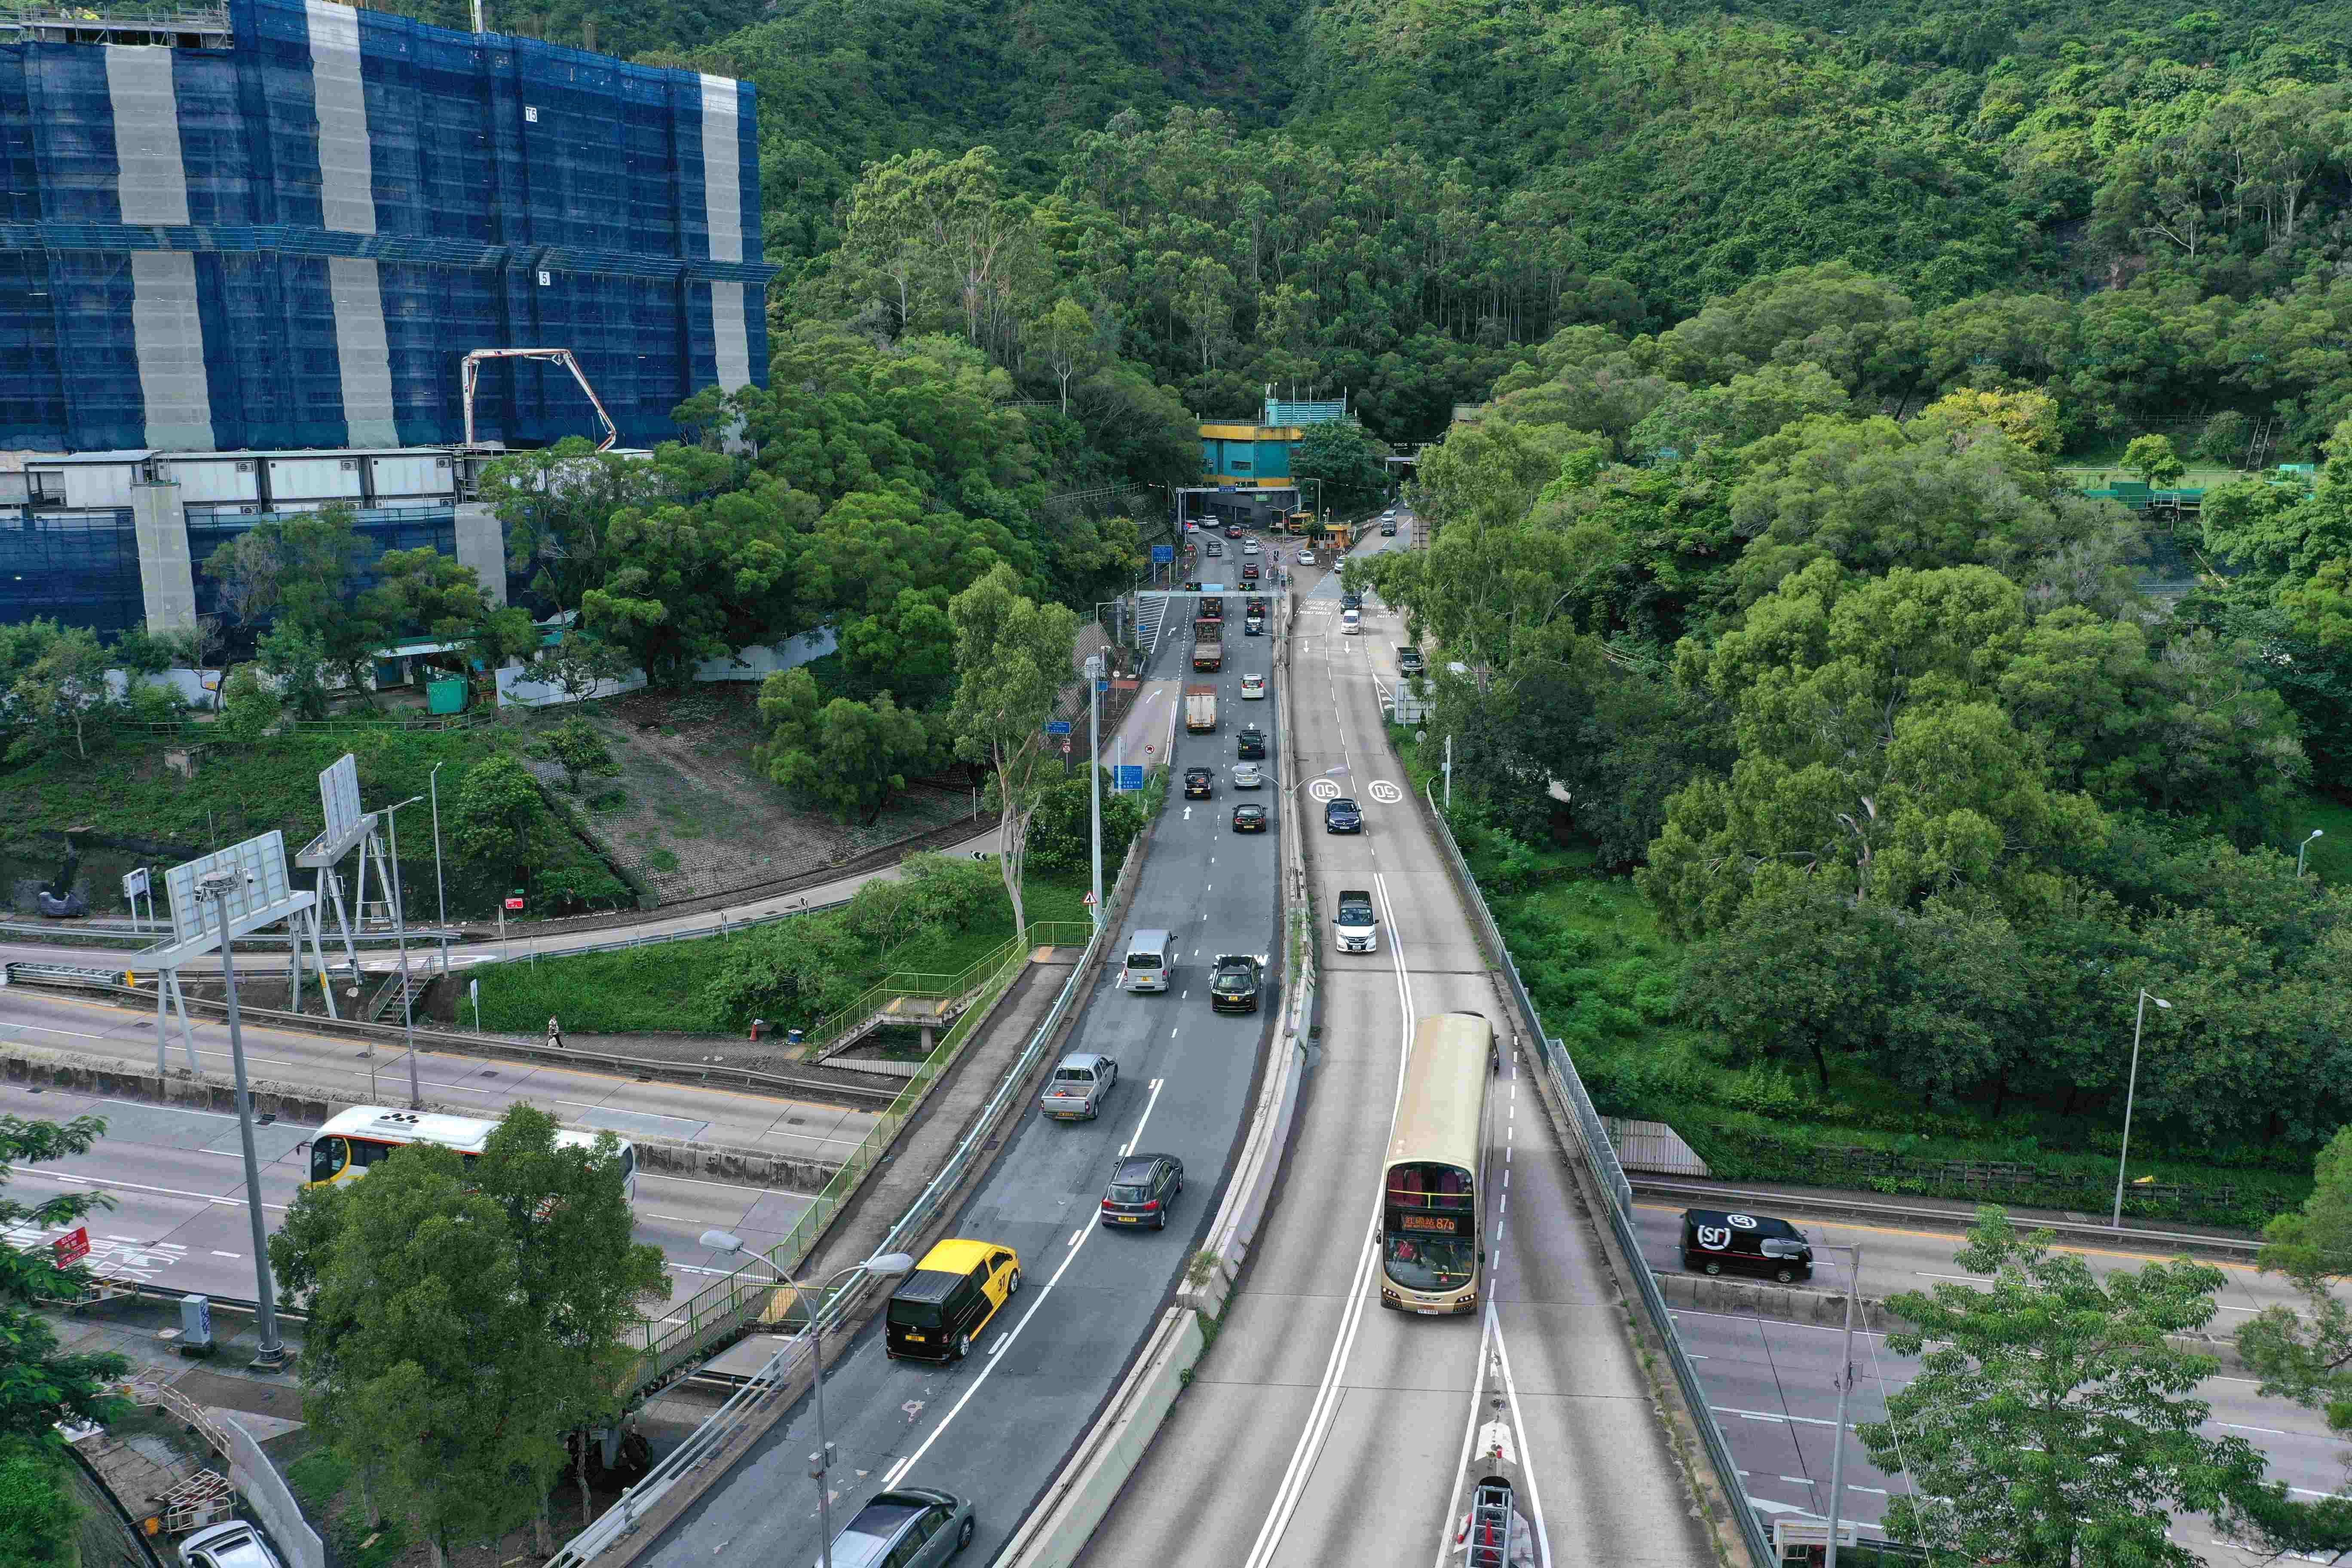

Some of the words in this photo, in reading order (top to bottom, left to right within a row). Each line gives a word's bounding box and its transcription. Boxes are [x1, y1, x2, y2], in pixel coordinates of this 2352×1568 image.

[527, 108, 536, 121] T5
[542, 273, 547, 284] 5
[1315, 784, 1335, 797] 50
[1374, 785, 1396, 798] 50
[1436, 1218, 1455, 1230] 87D
